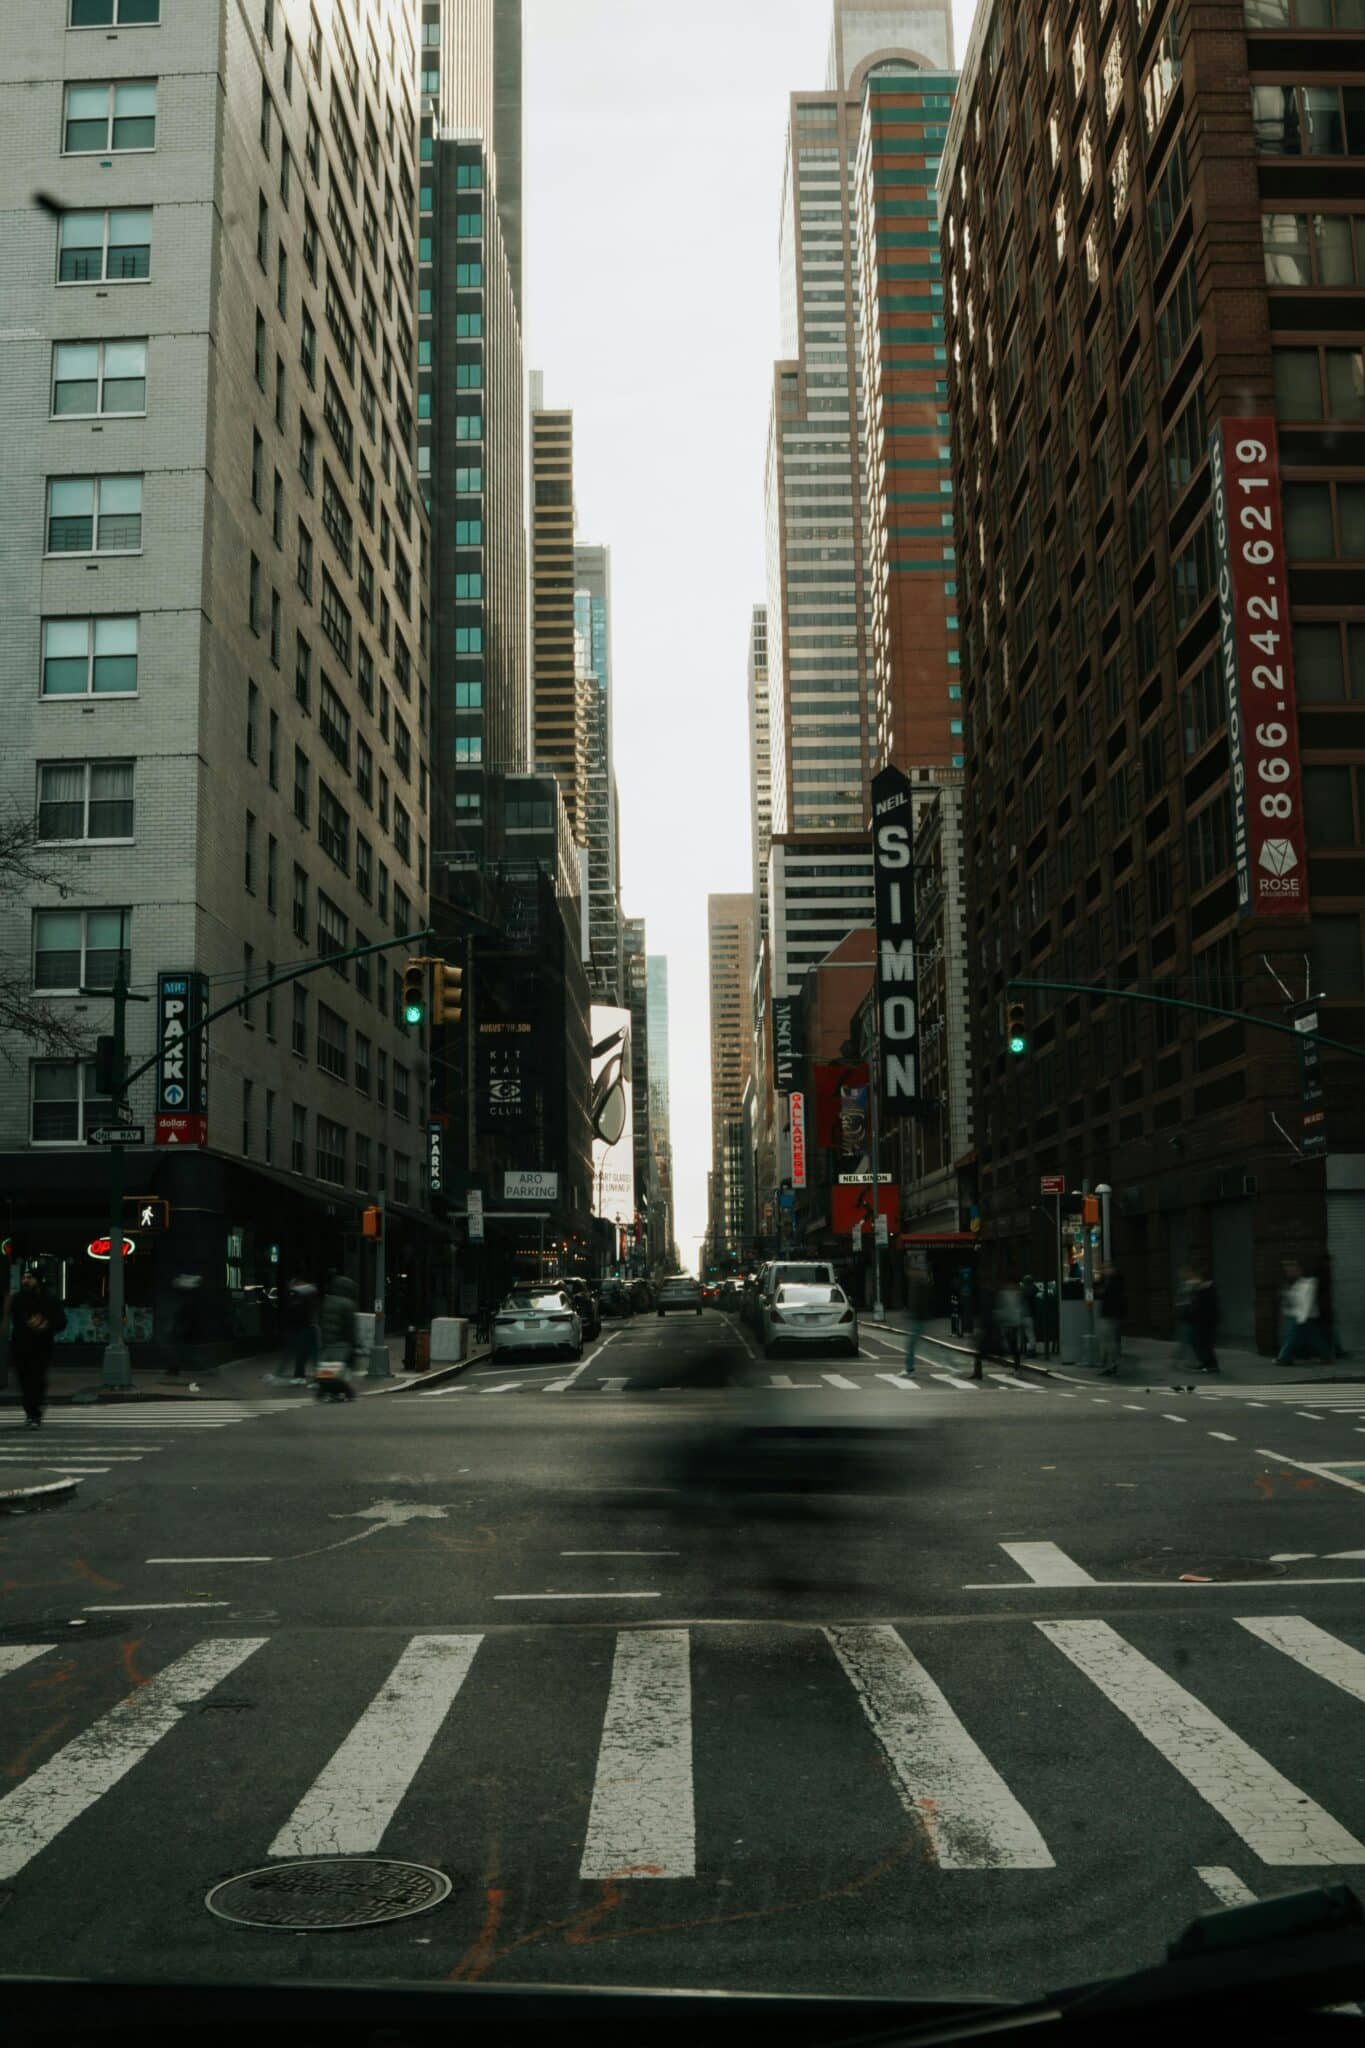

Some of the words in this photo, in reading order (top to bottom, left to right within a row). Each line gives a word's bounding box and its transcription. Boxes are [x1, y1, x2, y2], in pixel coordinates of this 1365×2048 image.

[1235, 438, 1292, 820] 866.242.6219
[1212, 440, 1250, 905] EllingtonNYC.com
[876, 792, 908, 816] NEIL
[1259, 879, 1300, 890] ROSE
[877, 825, 916, 1097] SIMON
[431, 1134, 440, 1178] PARK
[506, 1186, 555, 1198] PARKING
[520, 1175, 543, 1184] ARO
